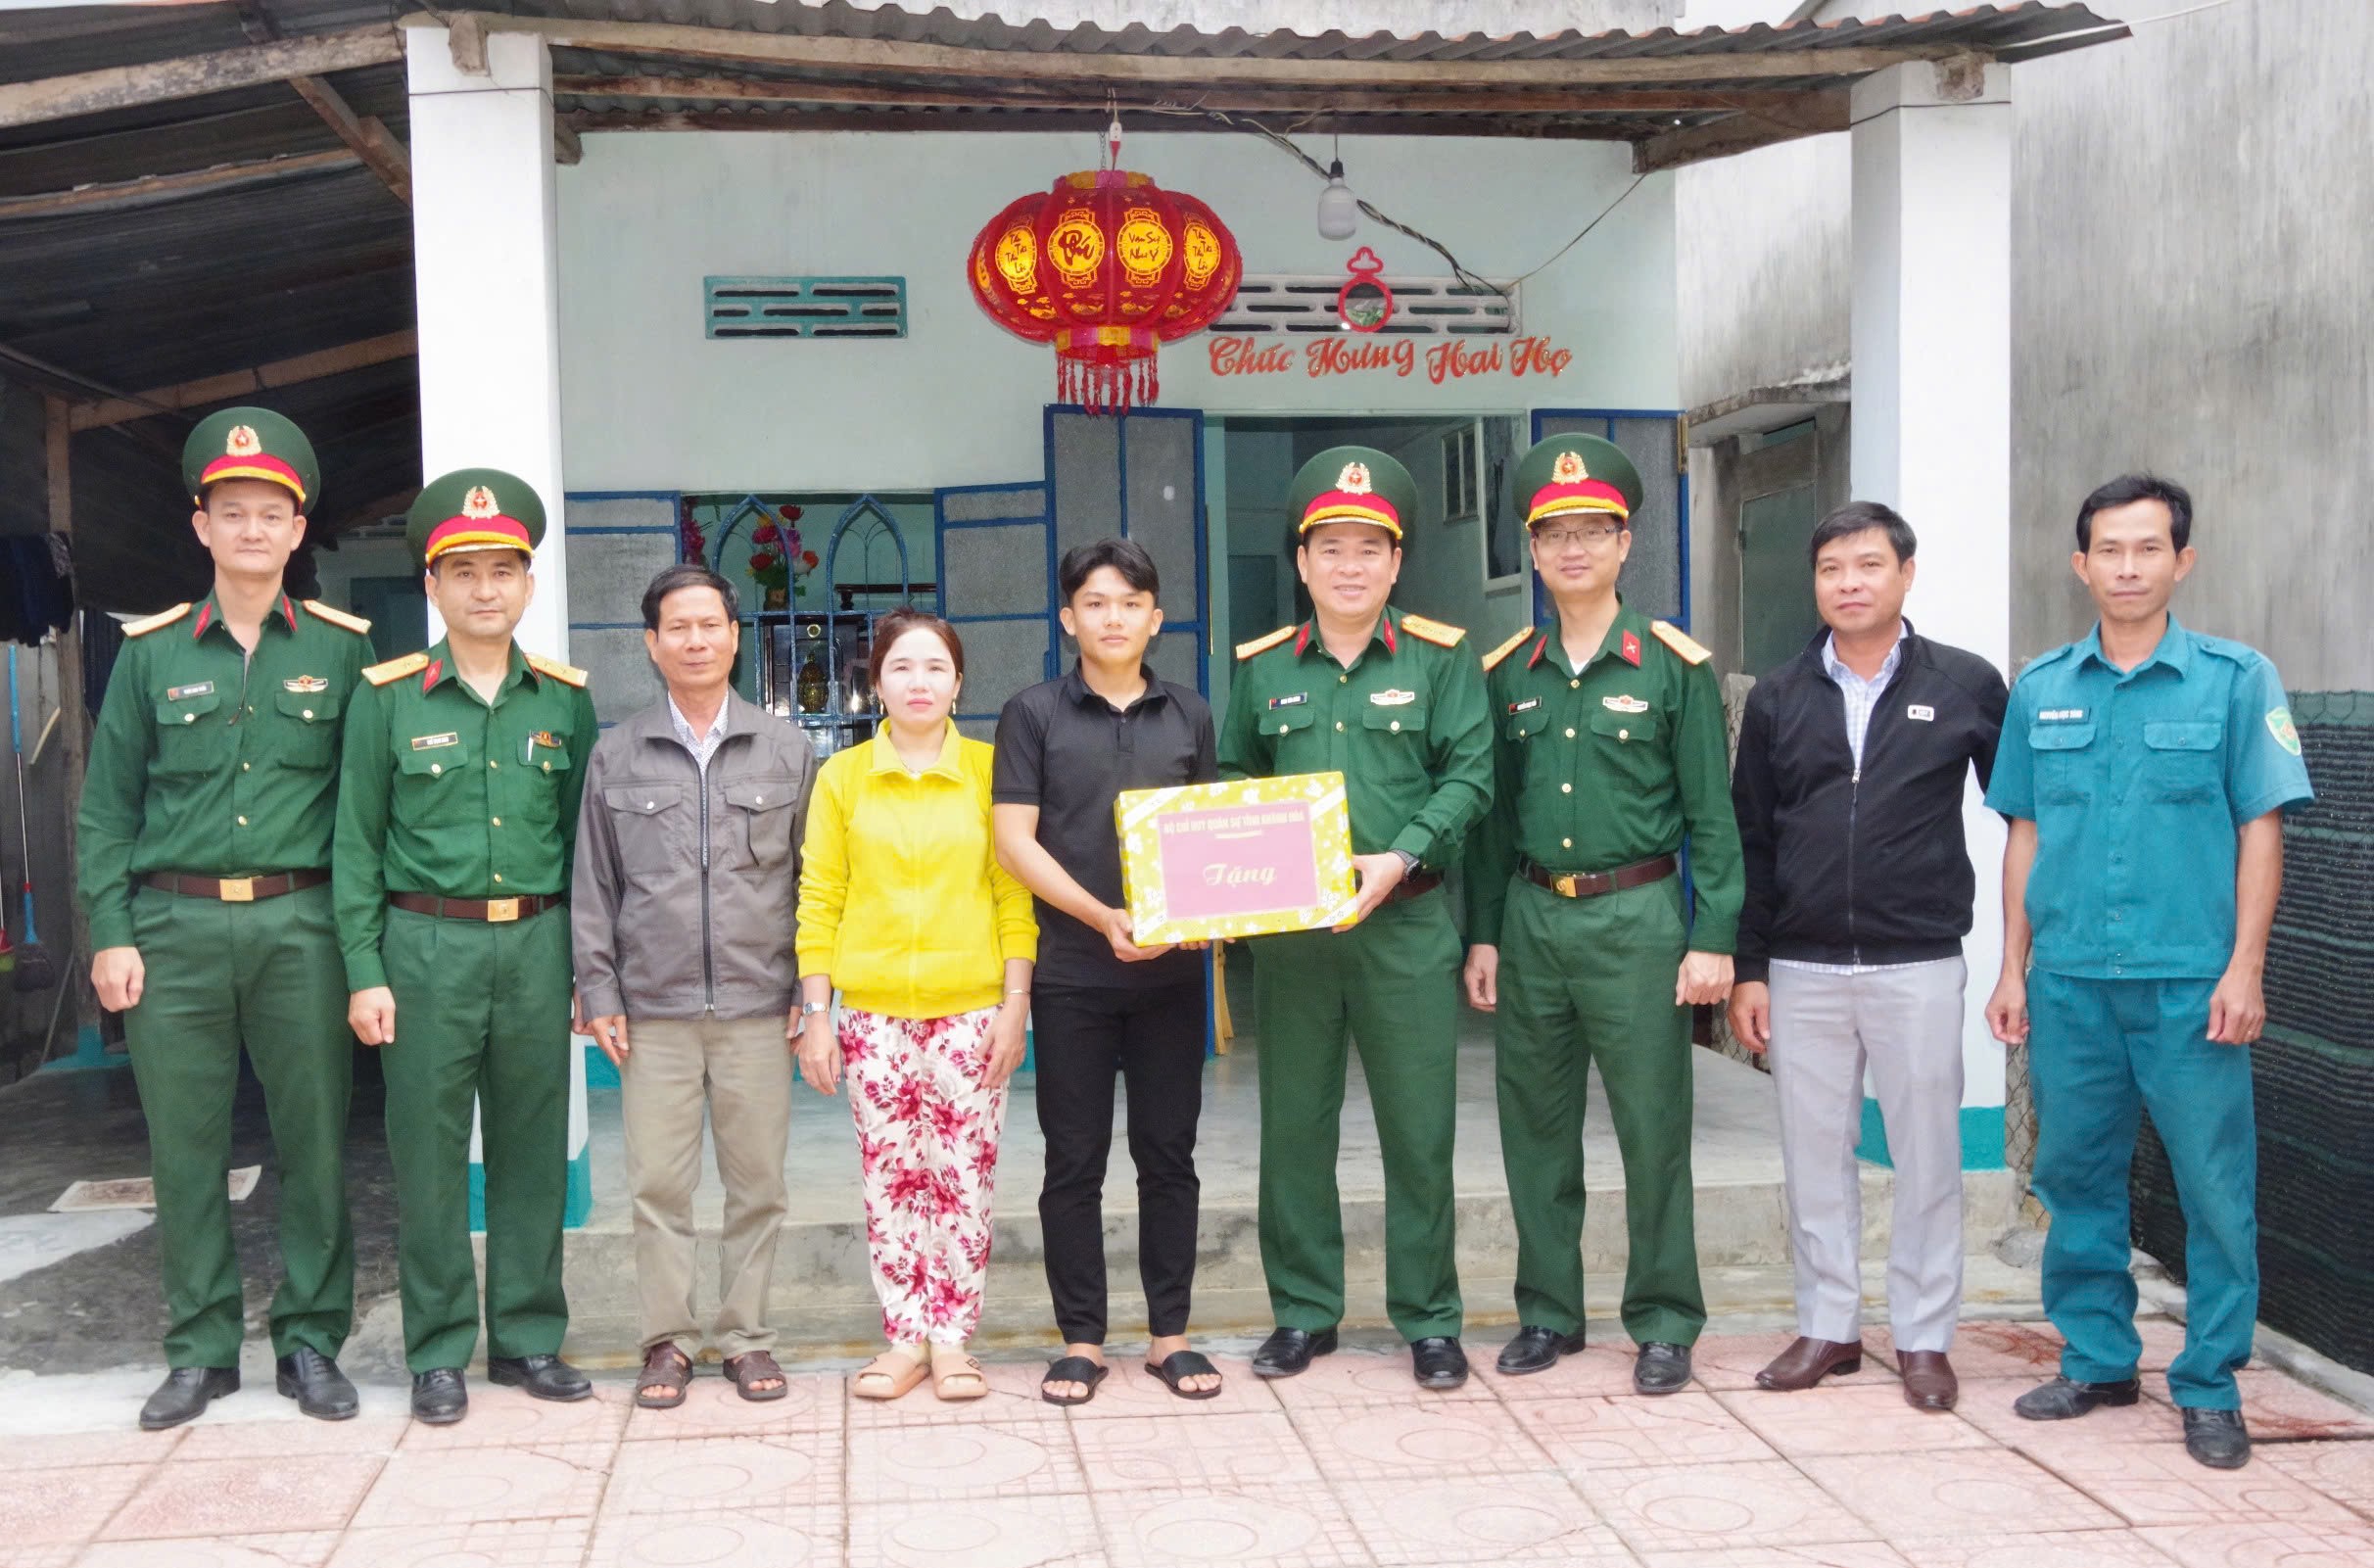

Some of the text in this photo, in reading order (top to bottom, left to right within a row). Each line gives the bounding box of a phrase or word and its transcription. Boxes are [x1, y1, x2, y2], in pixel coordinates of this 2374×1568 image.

[1426, 339, 1502, 385] Hai
[1509, 336, 1572, 377] Họ
[1202, 864, 1276, 888] Tặng
